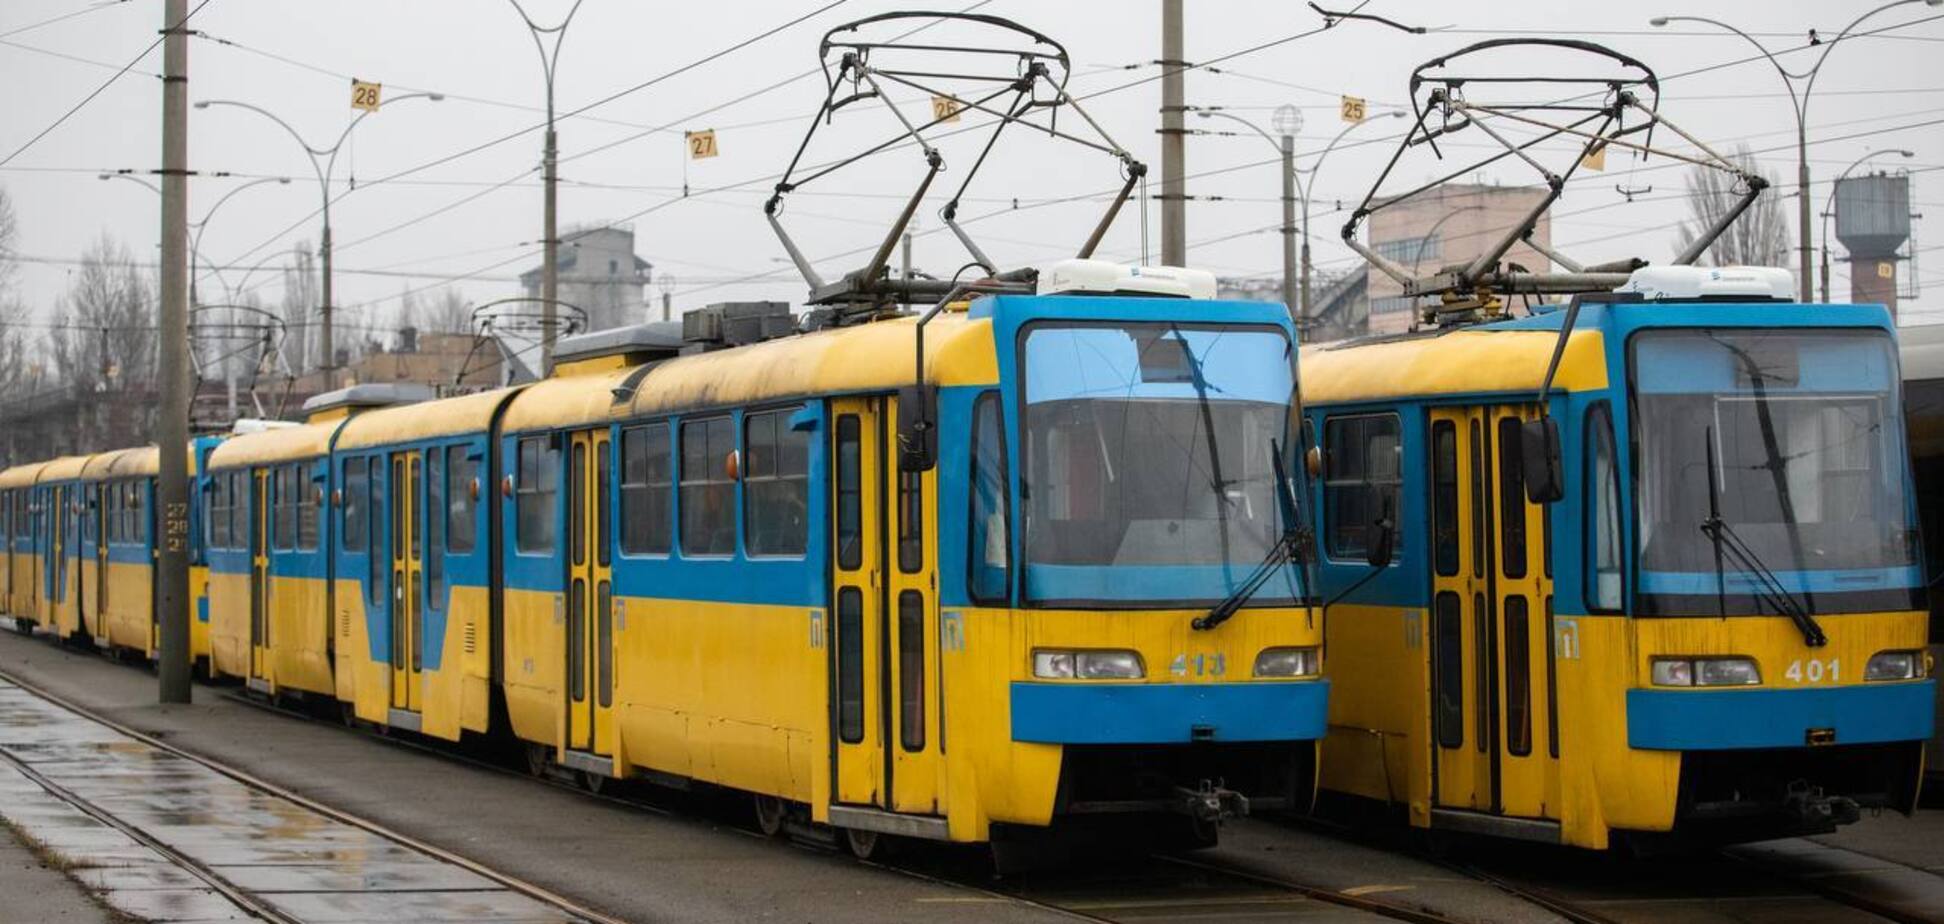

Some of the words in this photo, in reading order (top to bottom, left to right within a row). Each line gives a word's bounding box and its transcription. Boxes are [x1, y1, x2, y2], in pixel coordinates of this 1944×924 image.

[355, 87, 377, 106] 28
[1344, 102, 1363, 119] 25
[692, 136, 712, 154] 27
[1168, 653, 1226, 676] 413
[1784, 659, 1840, 681] 401
